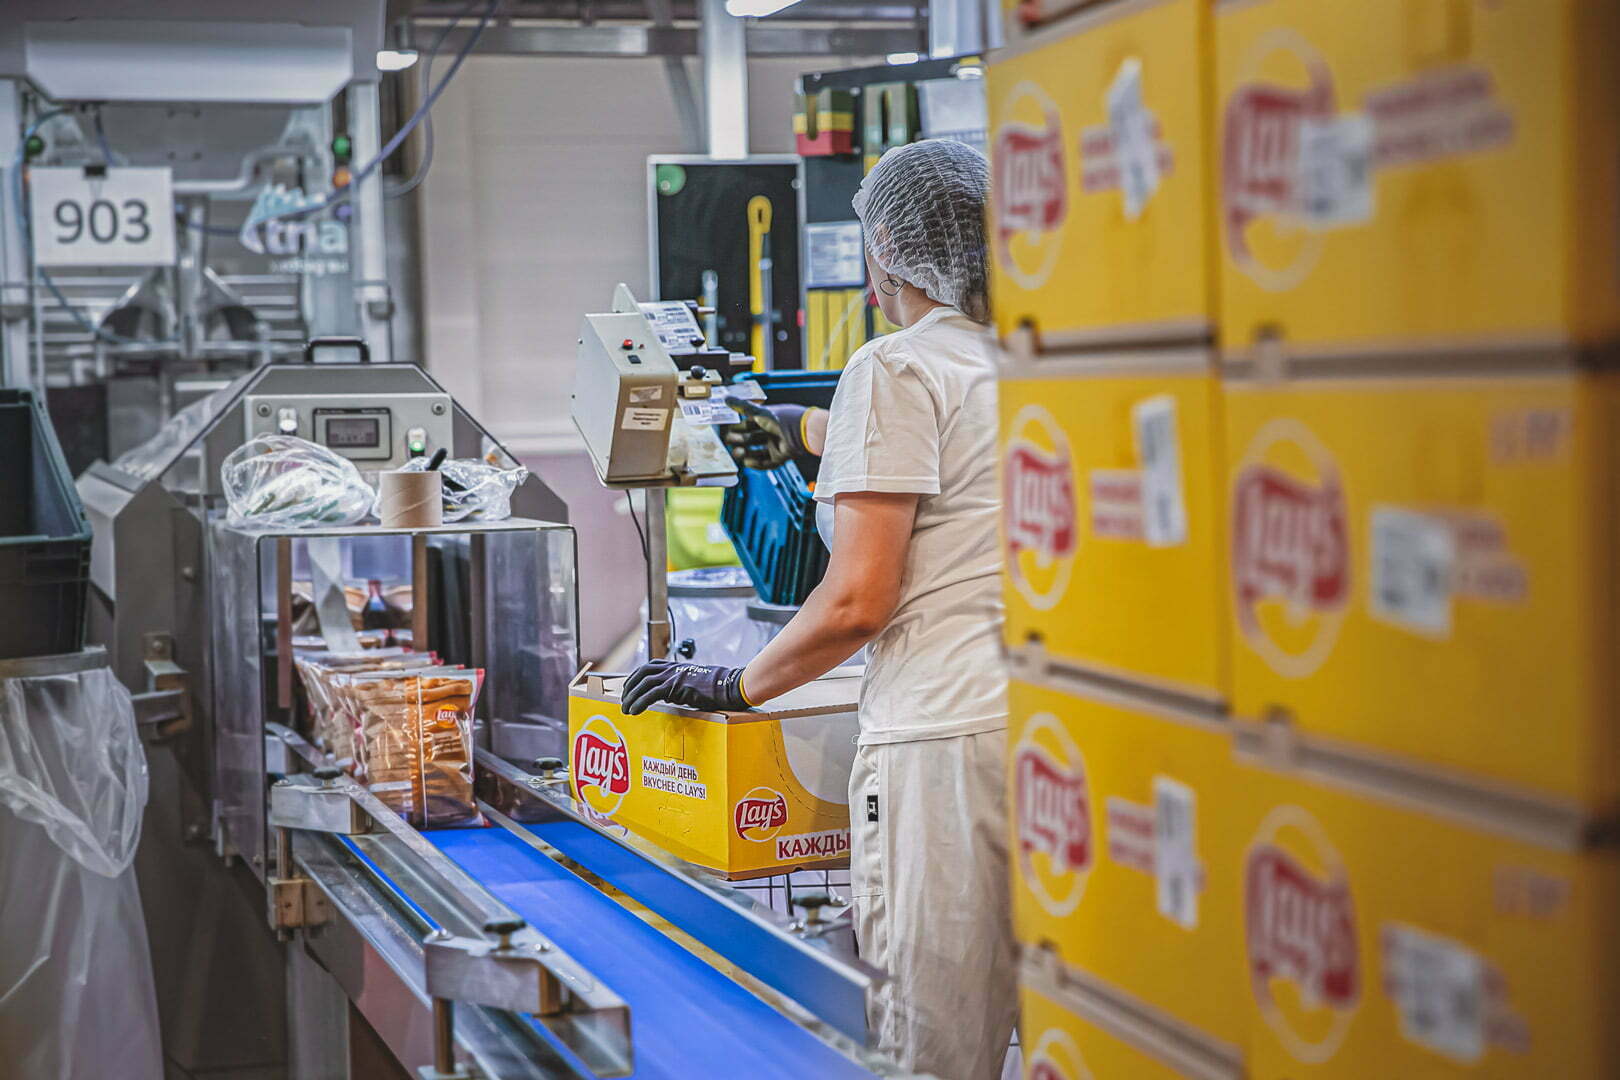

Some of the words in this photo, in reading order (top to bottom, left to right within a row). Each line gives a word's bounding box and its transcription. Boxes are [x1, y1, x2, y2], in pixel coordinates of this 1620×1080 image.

[54, 199, 151, 244] 903
[578, 737, 627, 797] Lay's
[643, 760, 676, 777] КАЖДЫЙ
[677, 767, 698, 781] ДЕНЬ
[643, 775, 676, 793] ВКУСНЕЕ
[685, 784, 706, 799] LAY'S!
[739, 801, 783, 831] Lay's
[778, 833, 850, 859] КАЖДЫ
